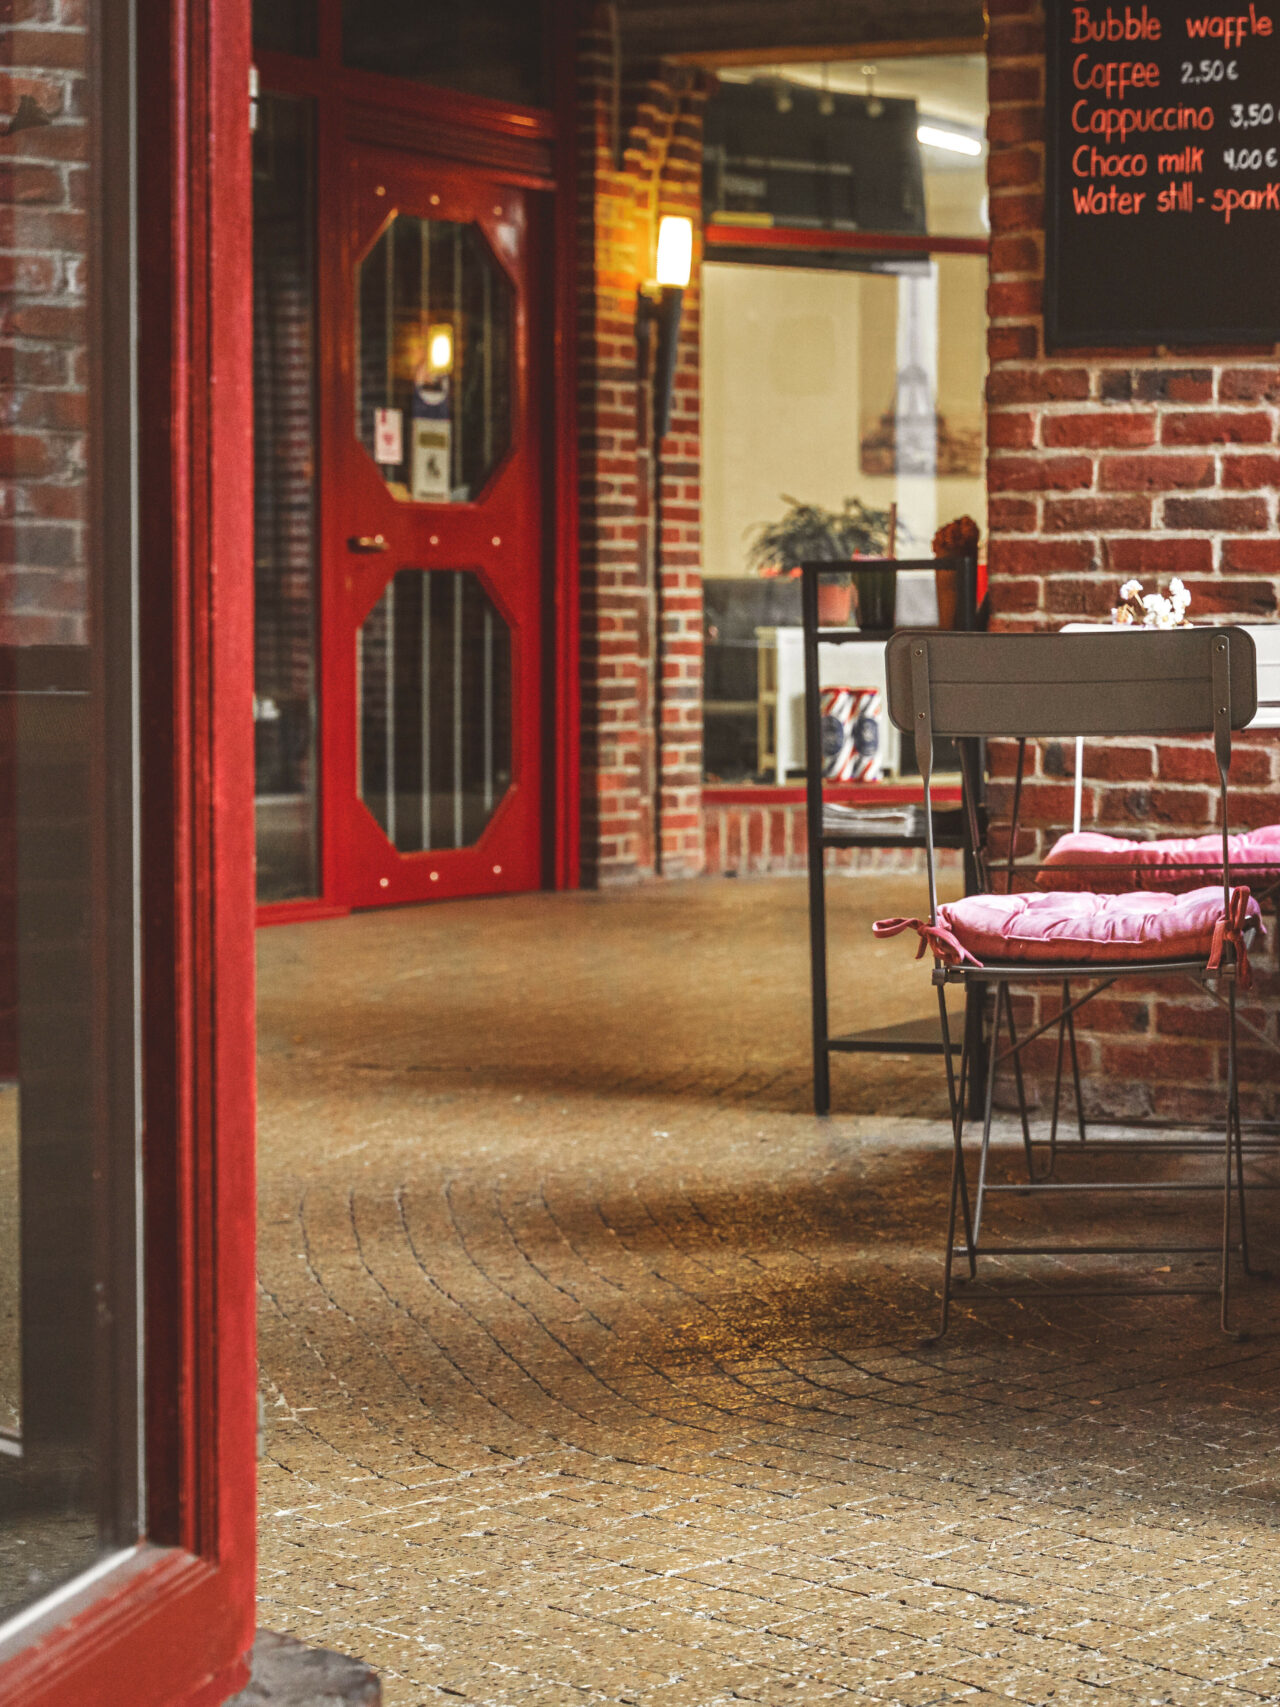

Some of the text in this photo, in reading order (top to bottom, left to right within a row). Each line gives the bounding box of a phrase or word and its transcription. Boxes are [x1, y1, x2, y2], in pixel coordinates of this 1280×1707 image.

[1070, 4, 1161, 44] Bubble
[1185, 2, 1273, 50] waffle
[1072, 53, 1160, 100] Coffee
[1071, 98, 1215, 143] Cappuccino
[1071, 143, 1148, 178] Choco
[1157, 145, 1205, 175] milk
[1072, 183, 1147, 215] Water
